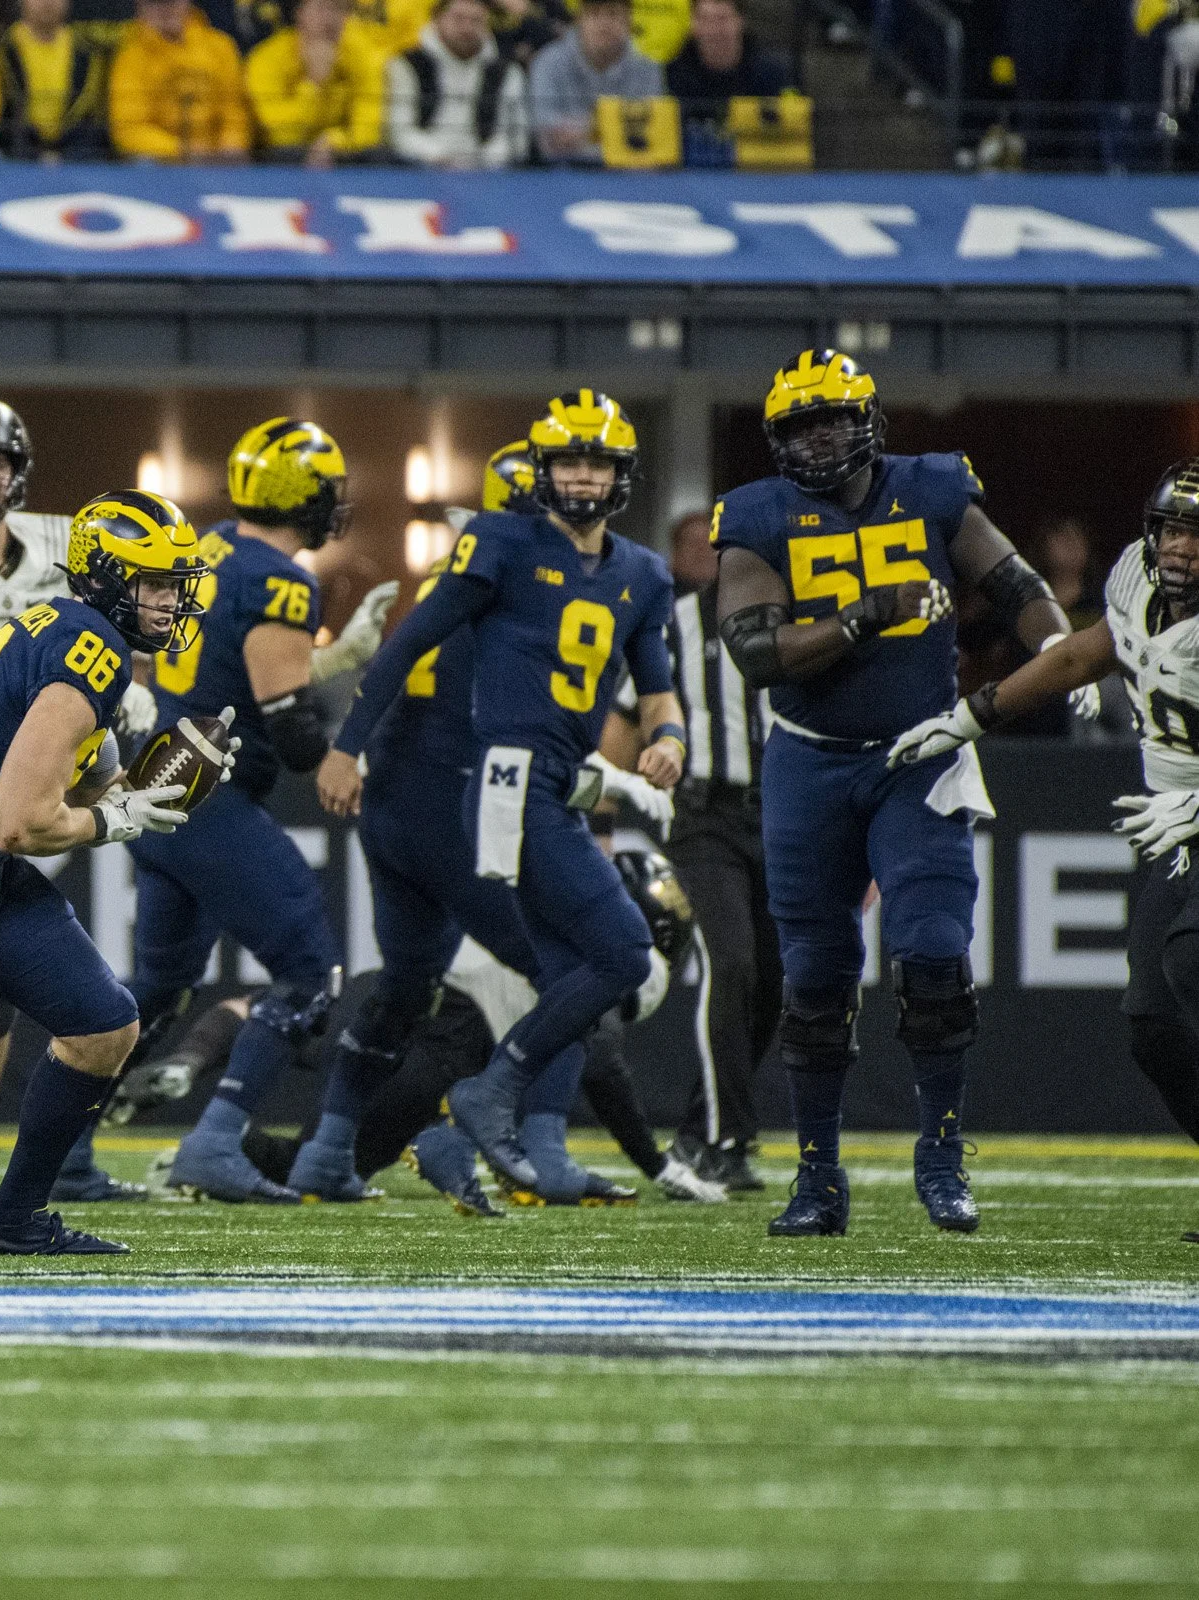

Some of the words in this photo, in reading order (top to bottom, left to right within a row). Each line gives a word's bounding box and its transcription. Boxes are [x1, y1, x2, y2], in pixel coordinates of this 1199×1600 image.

[451, 534, 478, 575] 9
[788, 518, 928, 638] 55
[264, 576, 311, 624] 76
[64, 630, 122, 693] 86
[550, 598, 616, 713] 9
[488, 763, 519, 787] M
